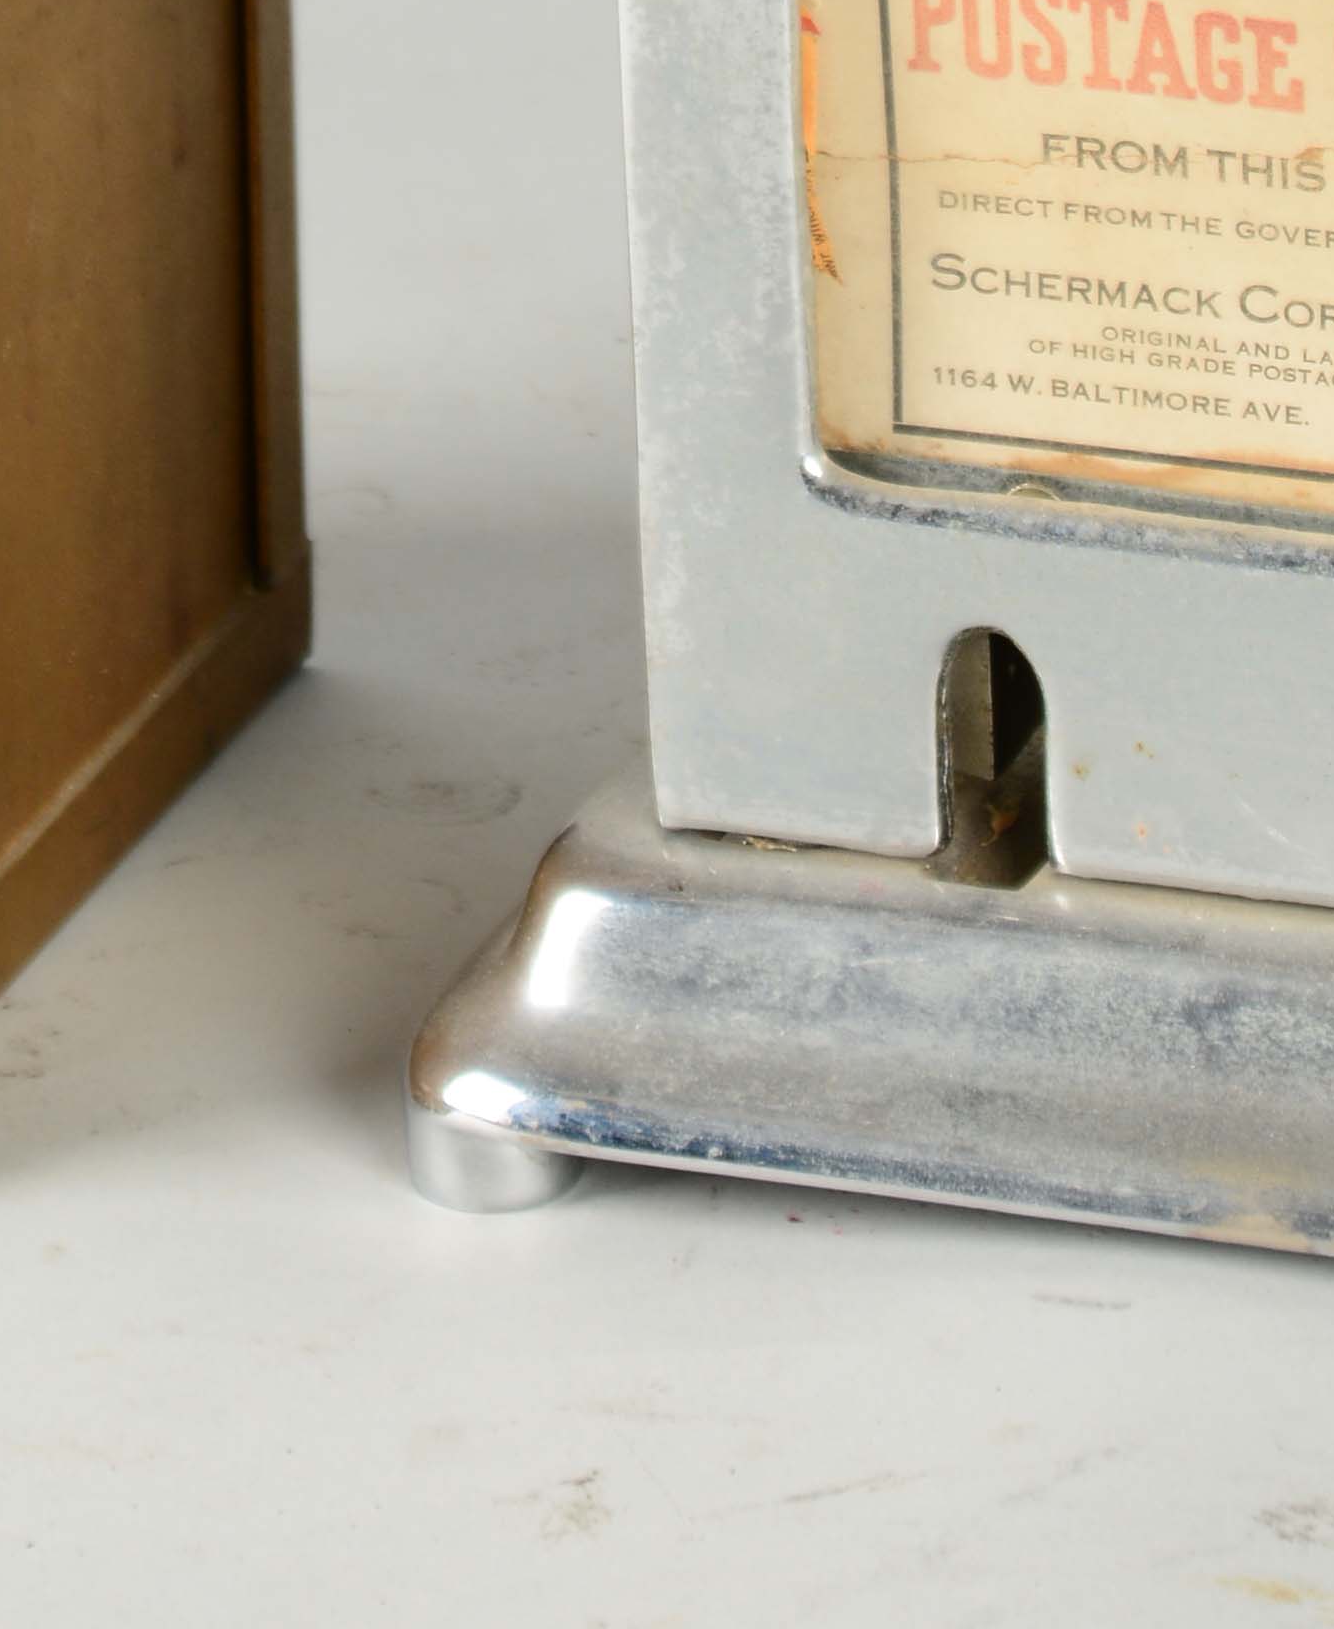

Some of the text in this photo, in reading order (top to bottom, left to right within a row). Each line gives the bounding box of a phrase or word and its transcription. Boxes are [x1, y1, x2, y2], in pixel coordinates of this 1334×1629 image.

[1041, 133, 1188, 180] FROM
[1206, 148, 1326, 192] THIS
[939, 190, 1054, 219] DIRECT
[1064, 202, 1152, 230] FROM
[1161, 212, 1222, 235] THE
[1028, 338, 1060, 356] OF
[1072, 343, 1135, 366] HIGH
[1147, 351, 1236, 376] GRADE
[1101, 325, 1227, 354] ORIGINAL
[1235, 339, 1291, 361] AND
[933, 366, 1311, 426] 1164 W. BALTIMORE AVE.
